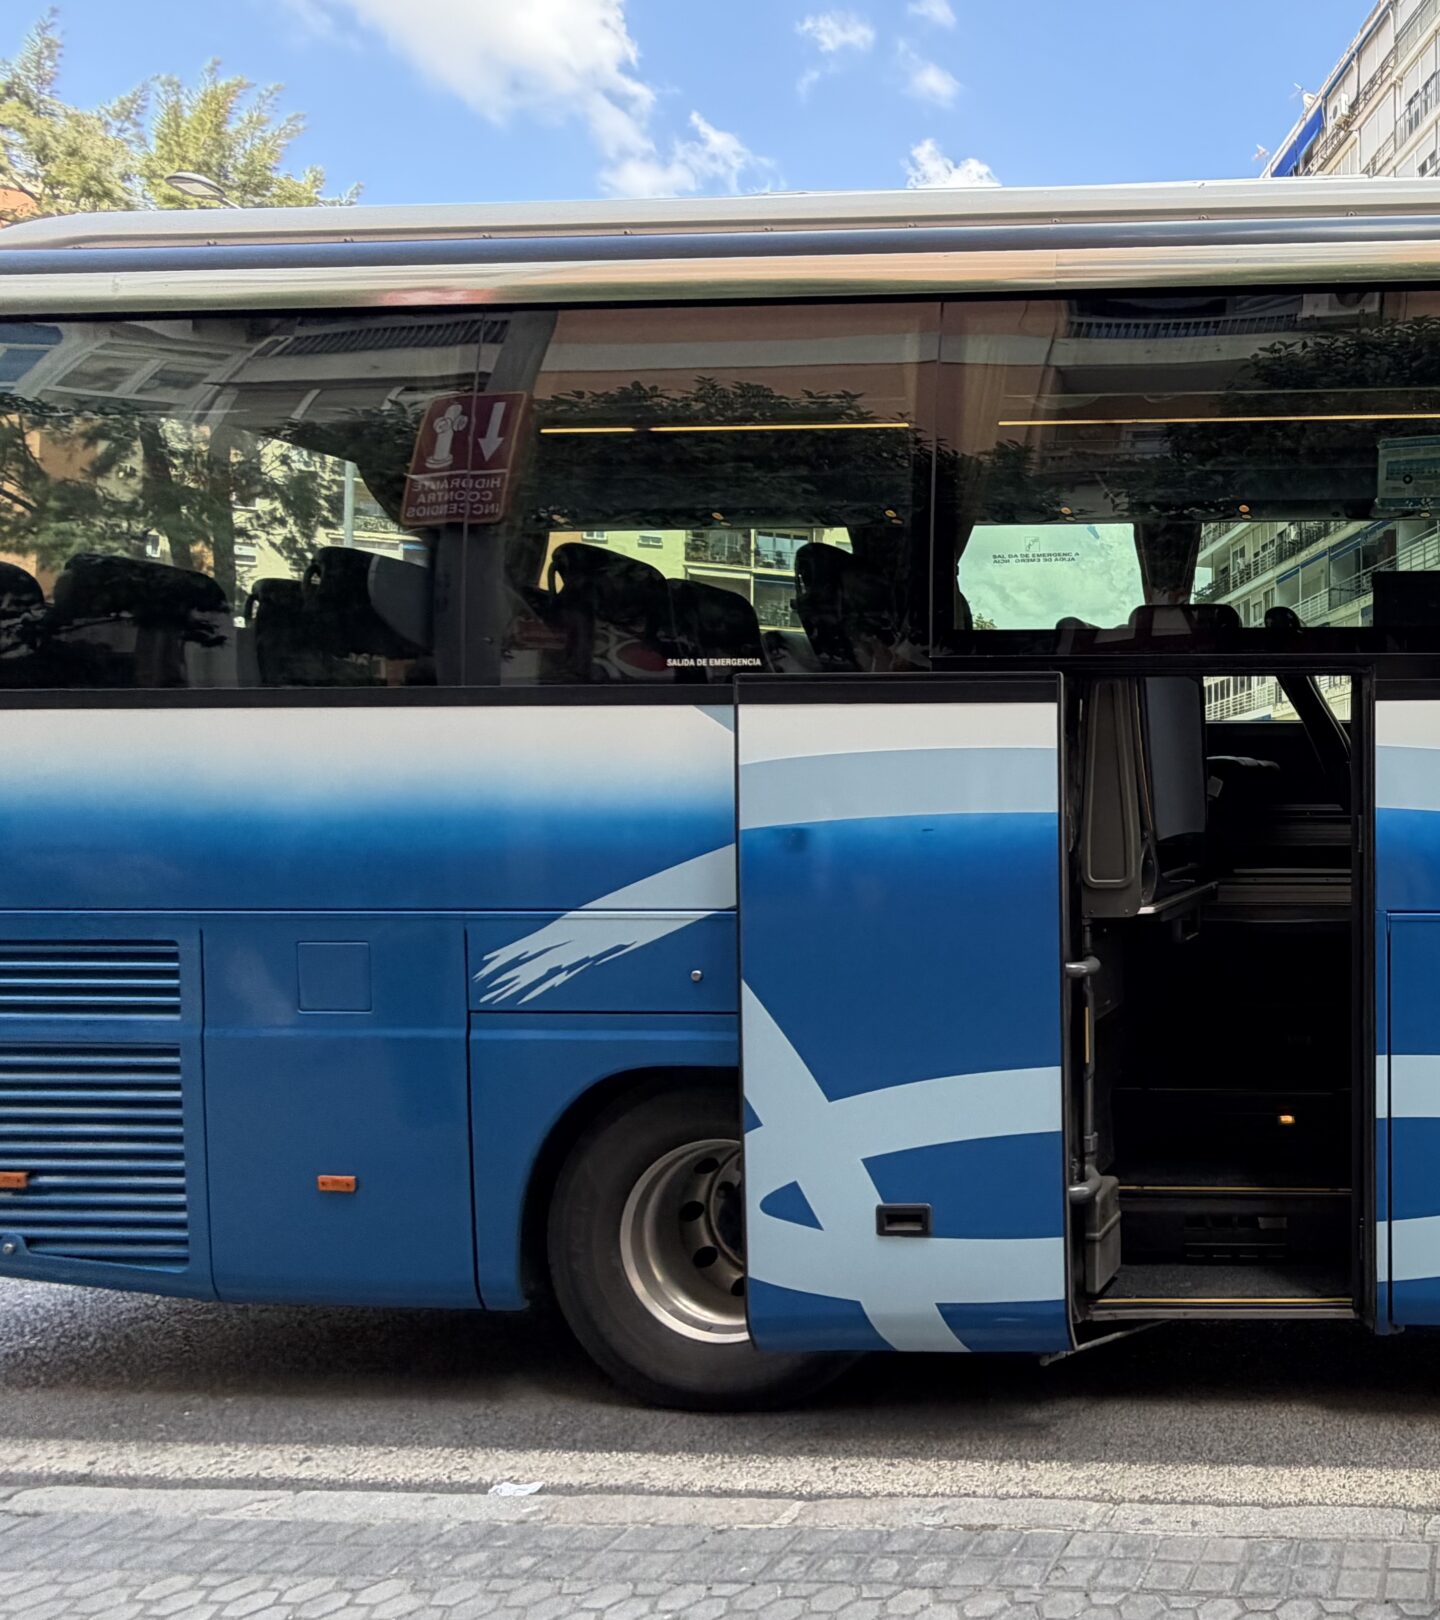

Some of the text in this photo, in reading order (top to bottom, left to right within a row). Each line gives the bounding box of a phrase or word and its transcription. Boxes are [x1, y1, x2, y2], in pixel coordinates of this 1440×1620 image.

[666, 657, 762, 667] SALIDA DE EMERGENCIA
